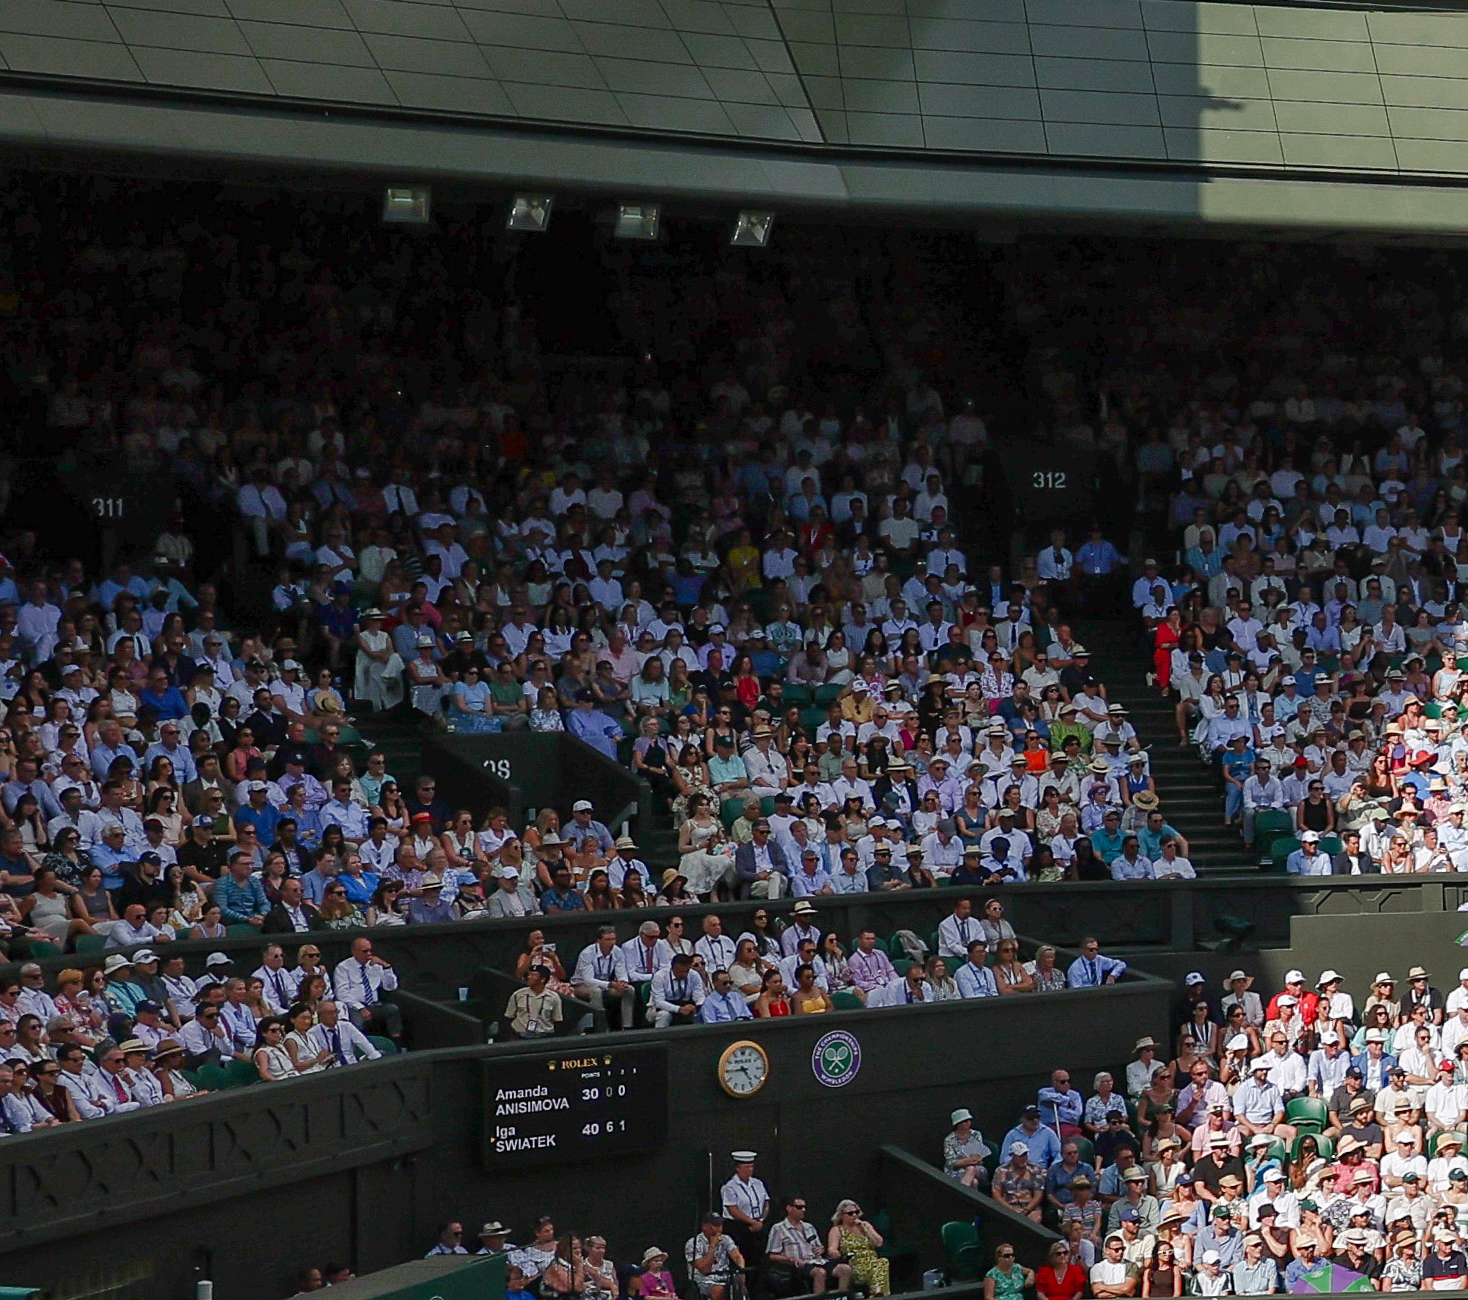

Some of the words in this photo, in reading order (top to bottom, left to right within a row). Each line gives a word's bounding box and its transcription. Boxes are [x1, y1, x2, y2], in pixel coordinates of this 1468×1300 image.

[1032, 471, 1066, 489] 312
[92, 498, 123, 517] 311
[561, 1057, 598, 1069] ROLEX
[820, 1071, 853, 1085] WIMBLEDON
[495, 1085, 548, 1101] Amanda
[582, 1087, 599, 1100] 30
[606, 1086, 613, 1097] 0
[618, 1085, 626, 1097] 0
[495, 1097, 570, 1116] ANISIMOVA
[496, 1125, 516, 1140] Iga
[582, 1123, 600, 1135] 40
[606, 1121, 614, 1133] 6
[619, 1119, 626, 1131] 1
[496, 1135, 556, 1153] SWIATEK
